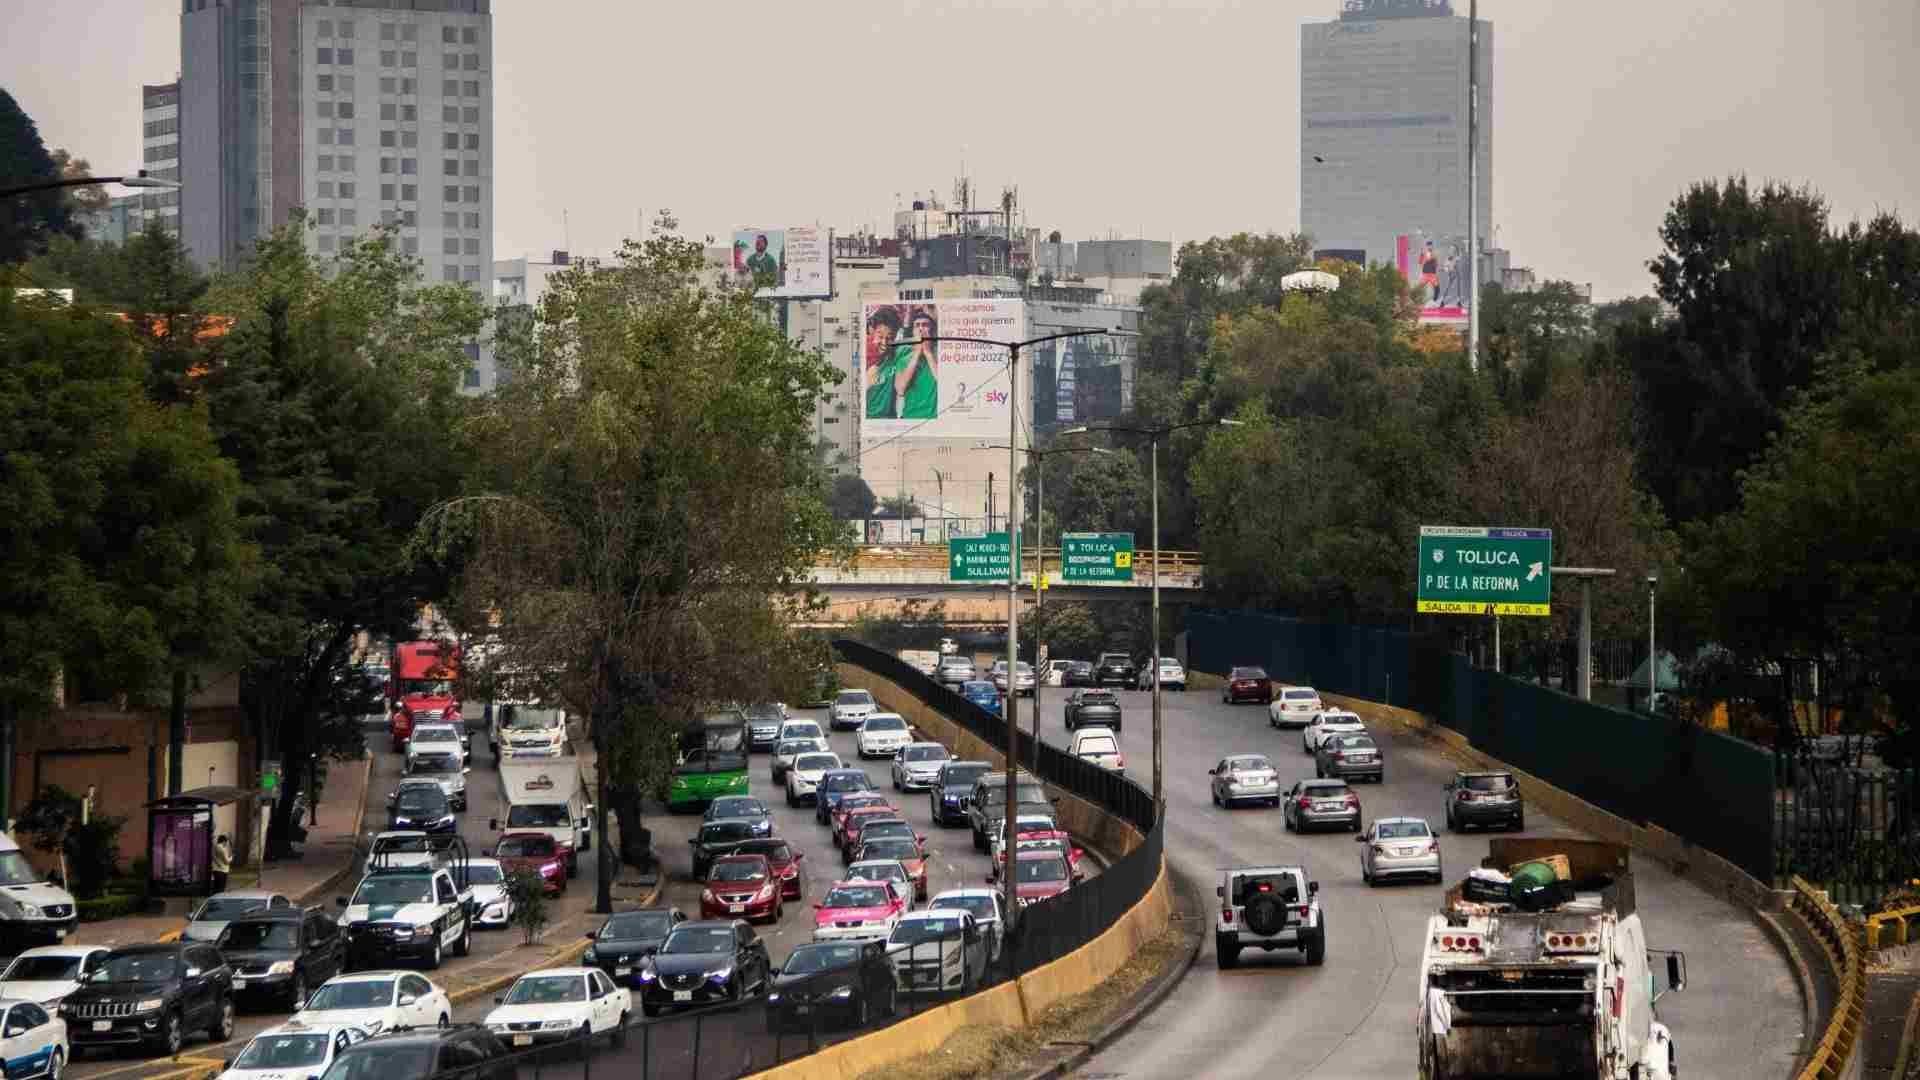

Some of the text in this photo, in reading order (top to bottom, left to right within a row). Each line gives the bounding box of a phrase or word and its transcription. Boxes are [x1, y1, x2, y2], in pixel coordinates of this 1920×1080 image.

[986, 389, 1009, 405] sky
[1080, 543, 1116, 553] TOLUCA
[1456, 550, 1520, 565] TOLUCA
[1426, 575, 1520, 591] P DE LA REFORMA
